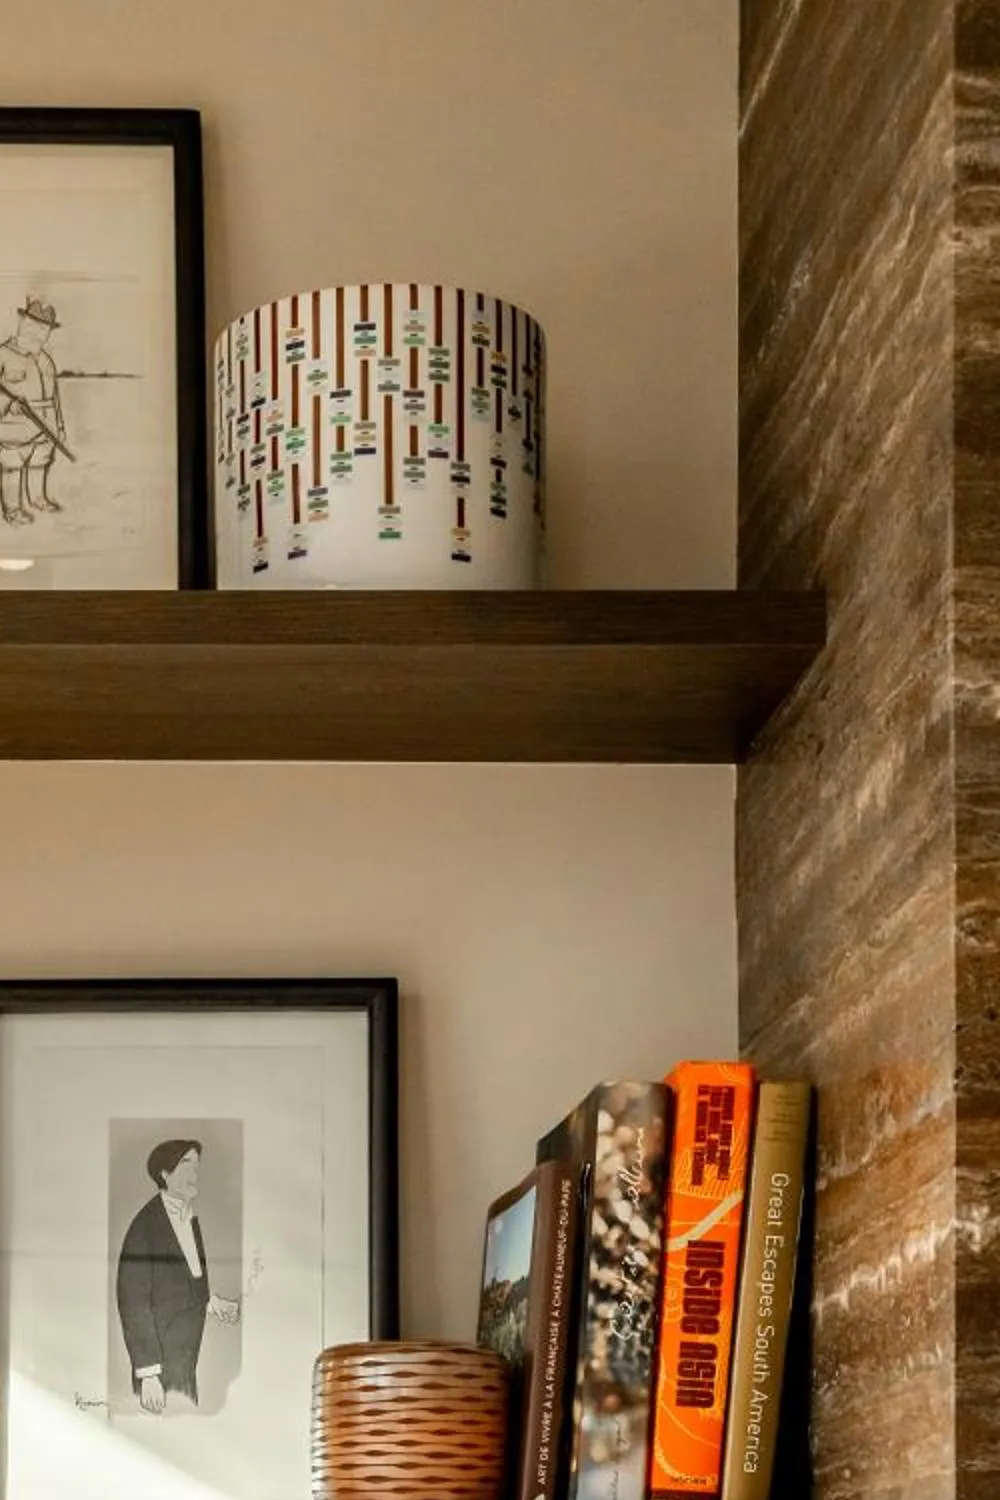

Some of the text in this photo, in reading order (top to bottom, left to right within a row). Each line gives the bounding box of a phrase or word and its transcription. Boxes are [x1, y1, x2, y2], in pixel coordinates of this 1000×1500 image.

[767, 1173, 789, 1227] Great
[758, 1235, 785, 1318] Escapes
[750, 1325, 775, 1383] South
[546, 1384, 556, 1398] LA
[541, 1411, 553, 1443] VIVRE
[743, 1388, 769, 1474] America
[537, 1465, 547, 1485] ART
[539, 1447, 549, 1460] DE
